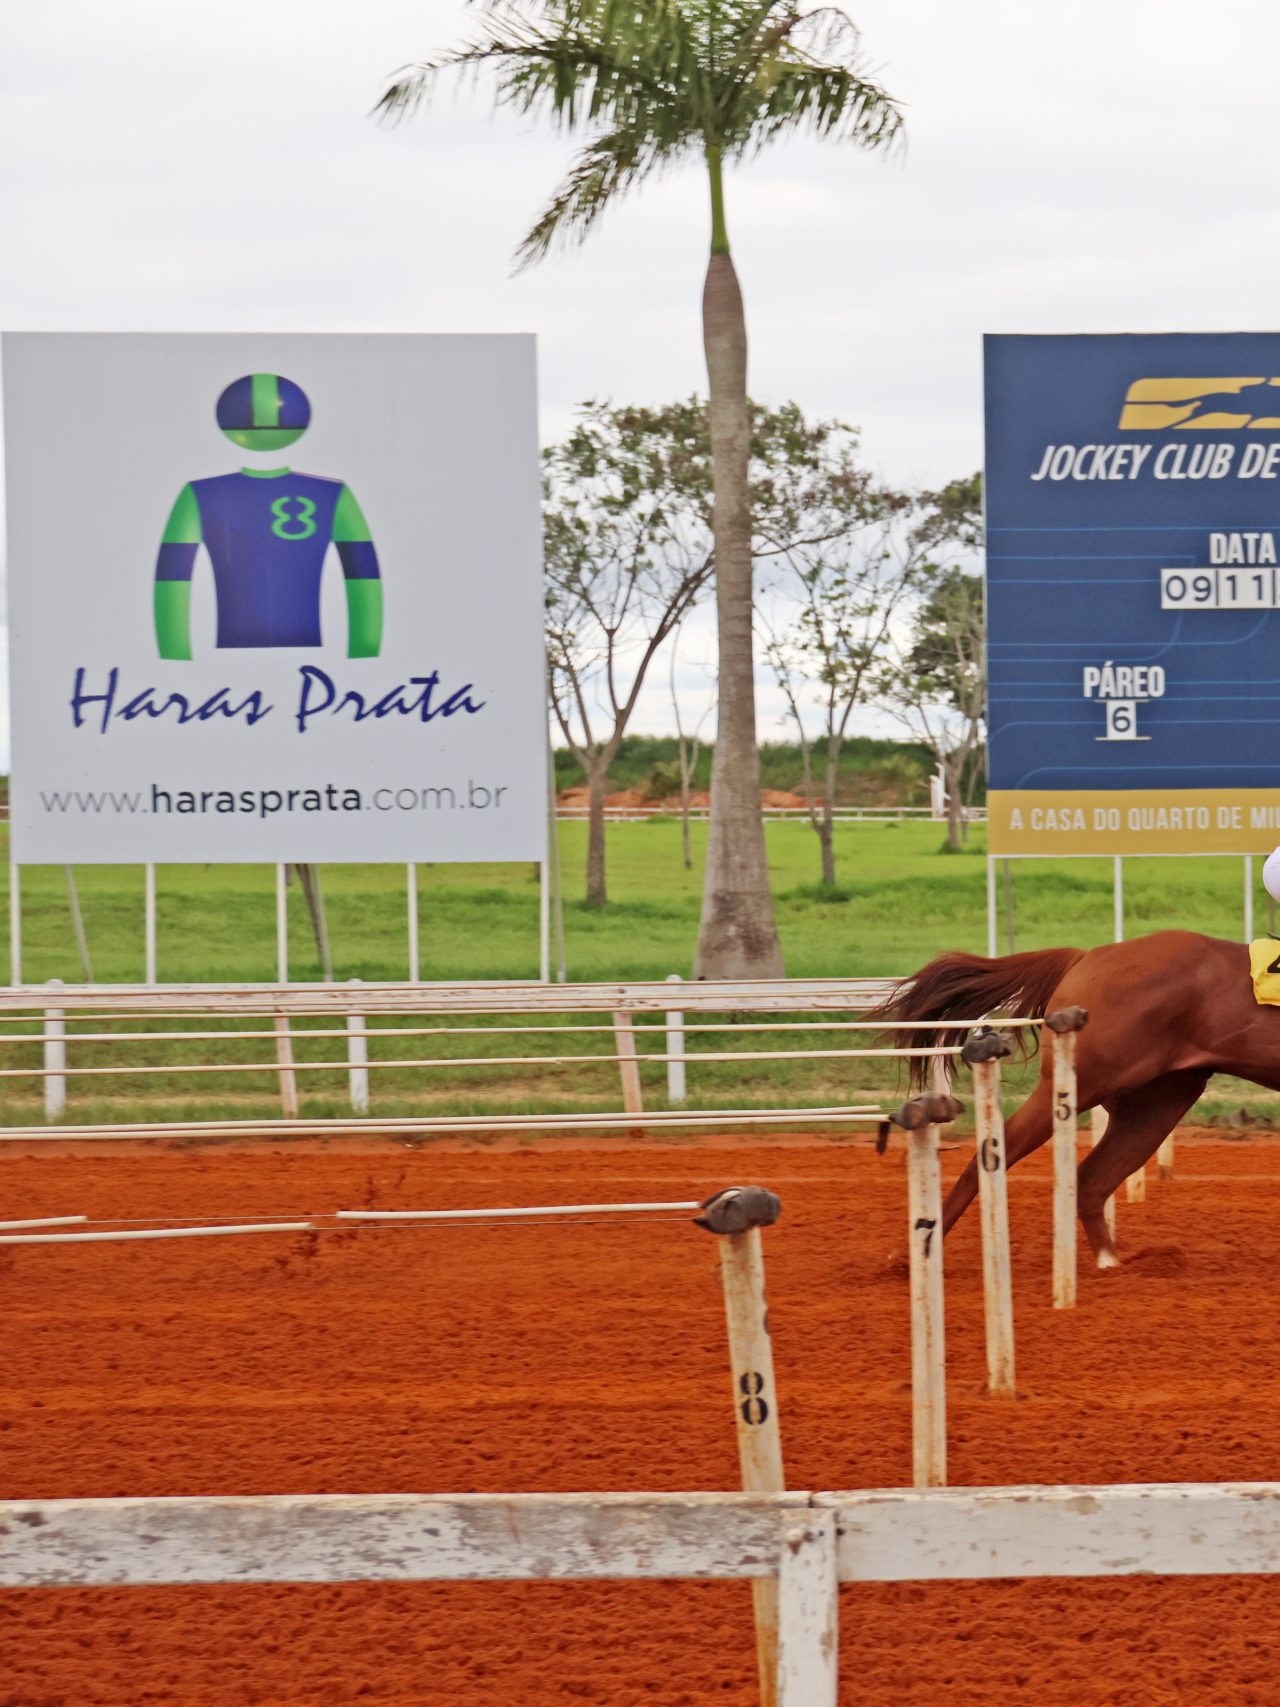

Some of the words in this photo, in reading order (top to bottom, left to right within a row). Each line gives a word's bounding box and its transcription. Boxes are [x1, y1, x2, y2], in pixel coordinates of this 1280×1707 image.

[1030, 444, 1154, 481] JOCKEY
[1153, 443, 1236, 480] CLUB
[1209, 532, 1278, 564] DATA
[1083, 660, 1165, 698] PÁREO
[71, 667, 274, 734] Haras
[296, 665, 486, 733] Prata
[1112, 706, 1131, 733] 6
[40, 779, 509, 818] www.harasprata.com.br
[1009, 807, 1024, 831] A
[1030, 807, 1087, 831] CASA
[1093, 807, 1121, 831] DO
[1127, 806, 1210, 831] QUARTO
[1216, 806, 1243, 830] DE
[1056, 1092, 1072, 1122] 5
[981, 1137, 1001, 1173] 6
[914, 1217, 937, 1260] 7
[739, 1371, 769, 1426] 8
